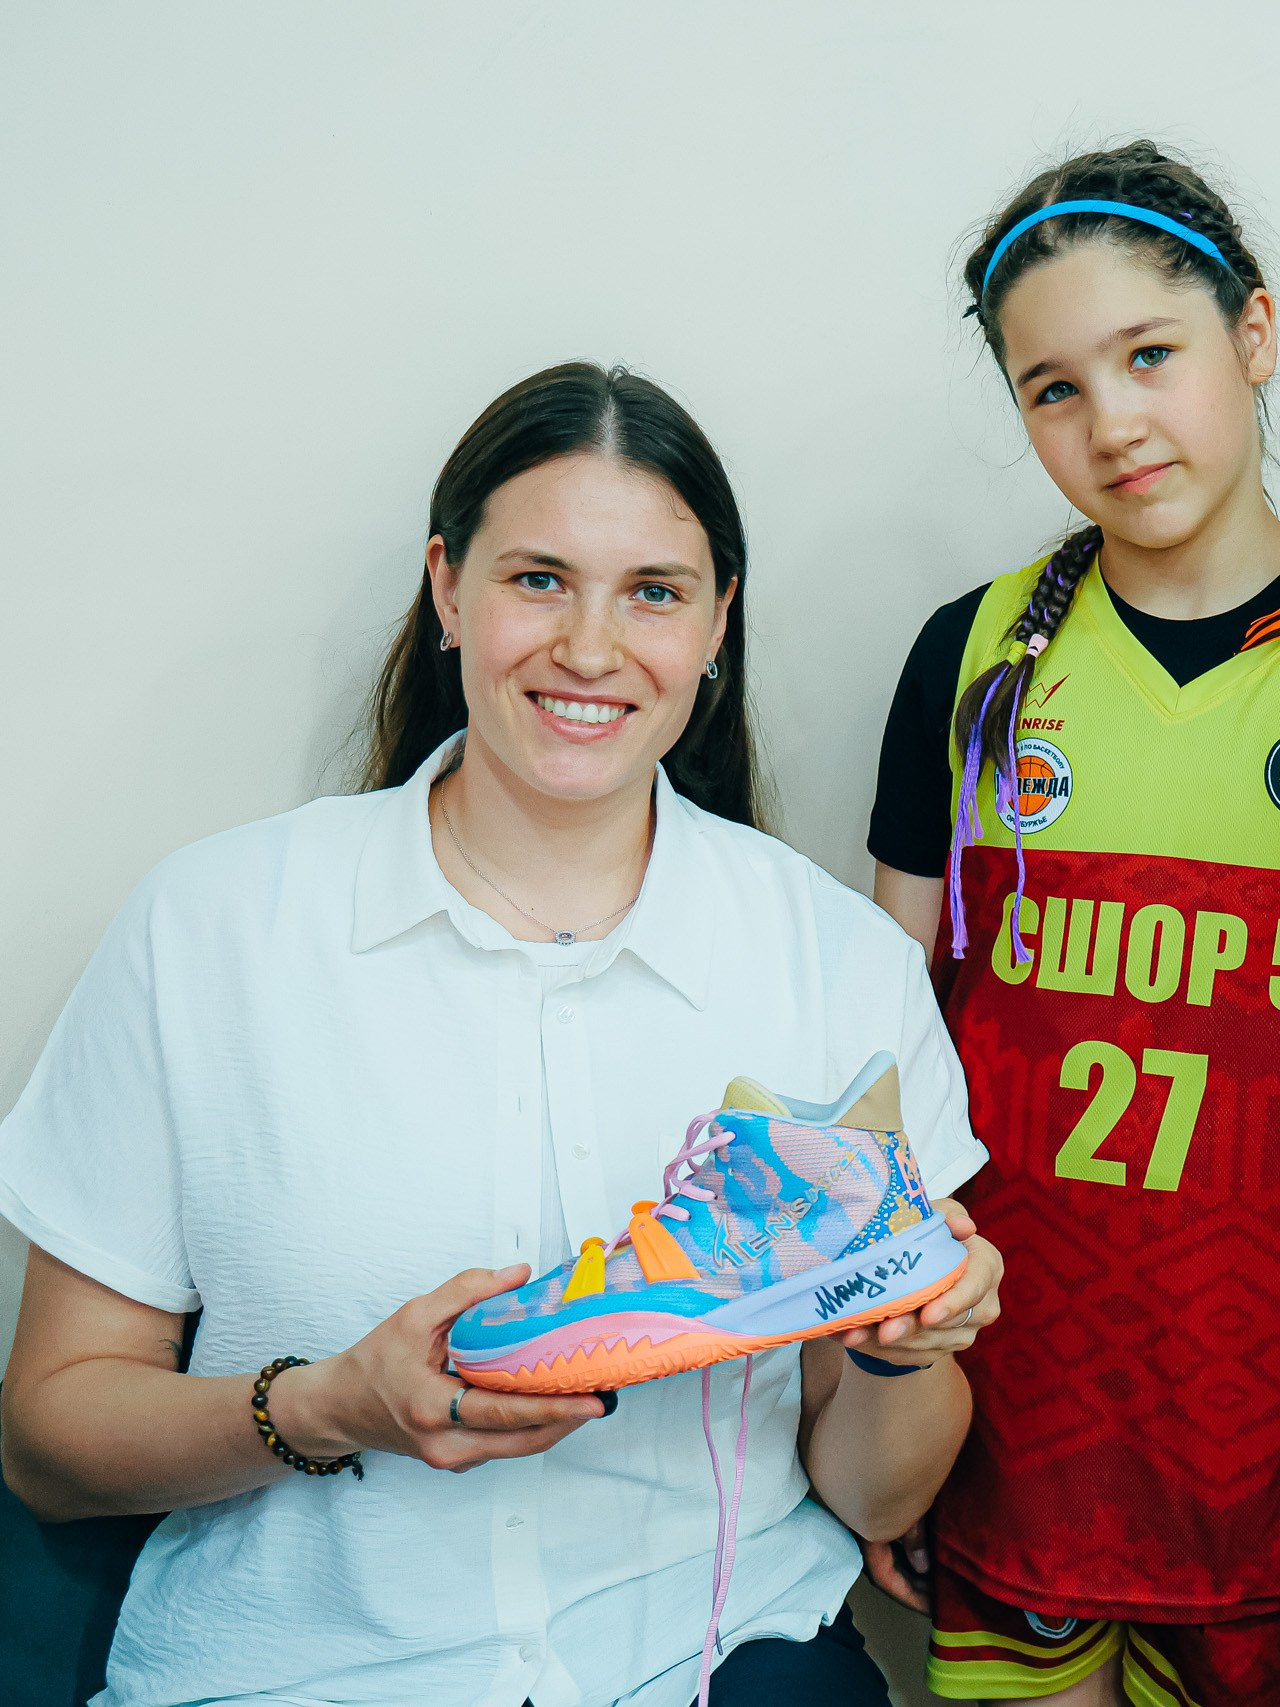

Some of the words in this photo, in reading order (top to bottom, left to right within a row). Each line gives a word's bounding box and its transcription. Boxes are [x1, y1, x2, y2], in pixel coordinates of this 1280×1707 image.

[1021, 717, 1066, 731] NRISE
[996, 773, 1069, 799] ЕЖДА
[991, 891, 1249, 1007] СШОР
[1055, 1040, 1209, 1192] 27
